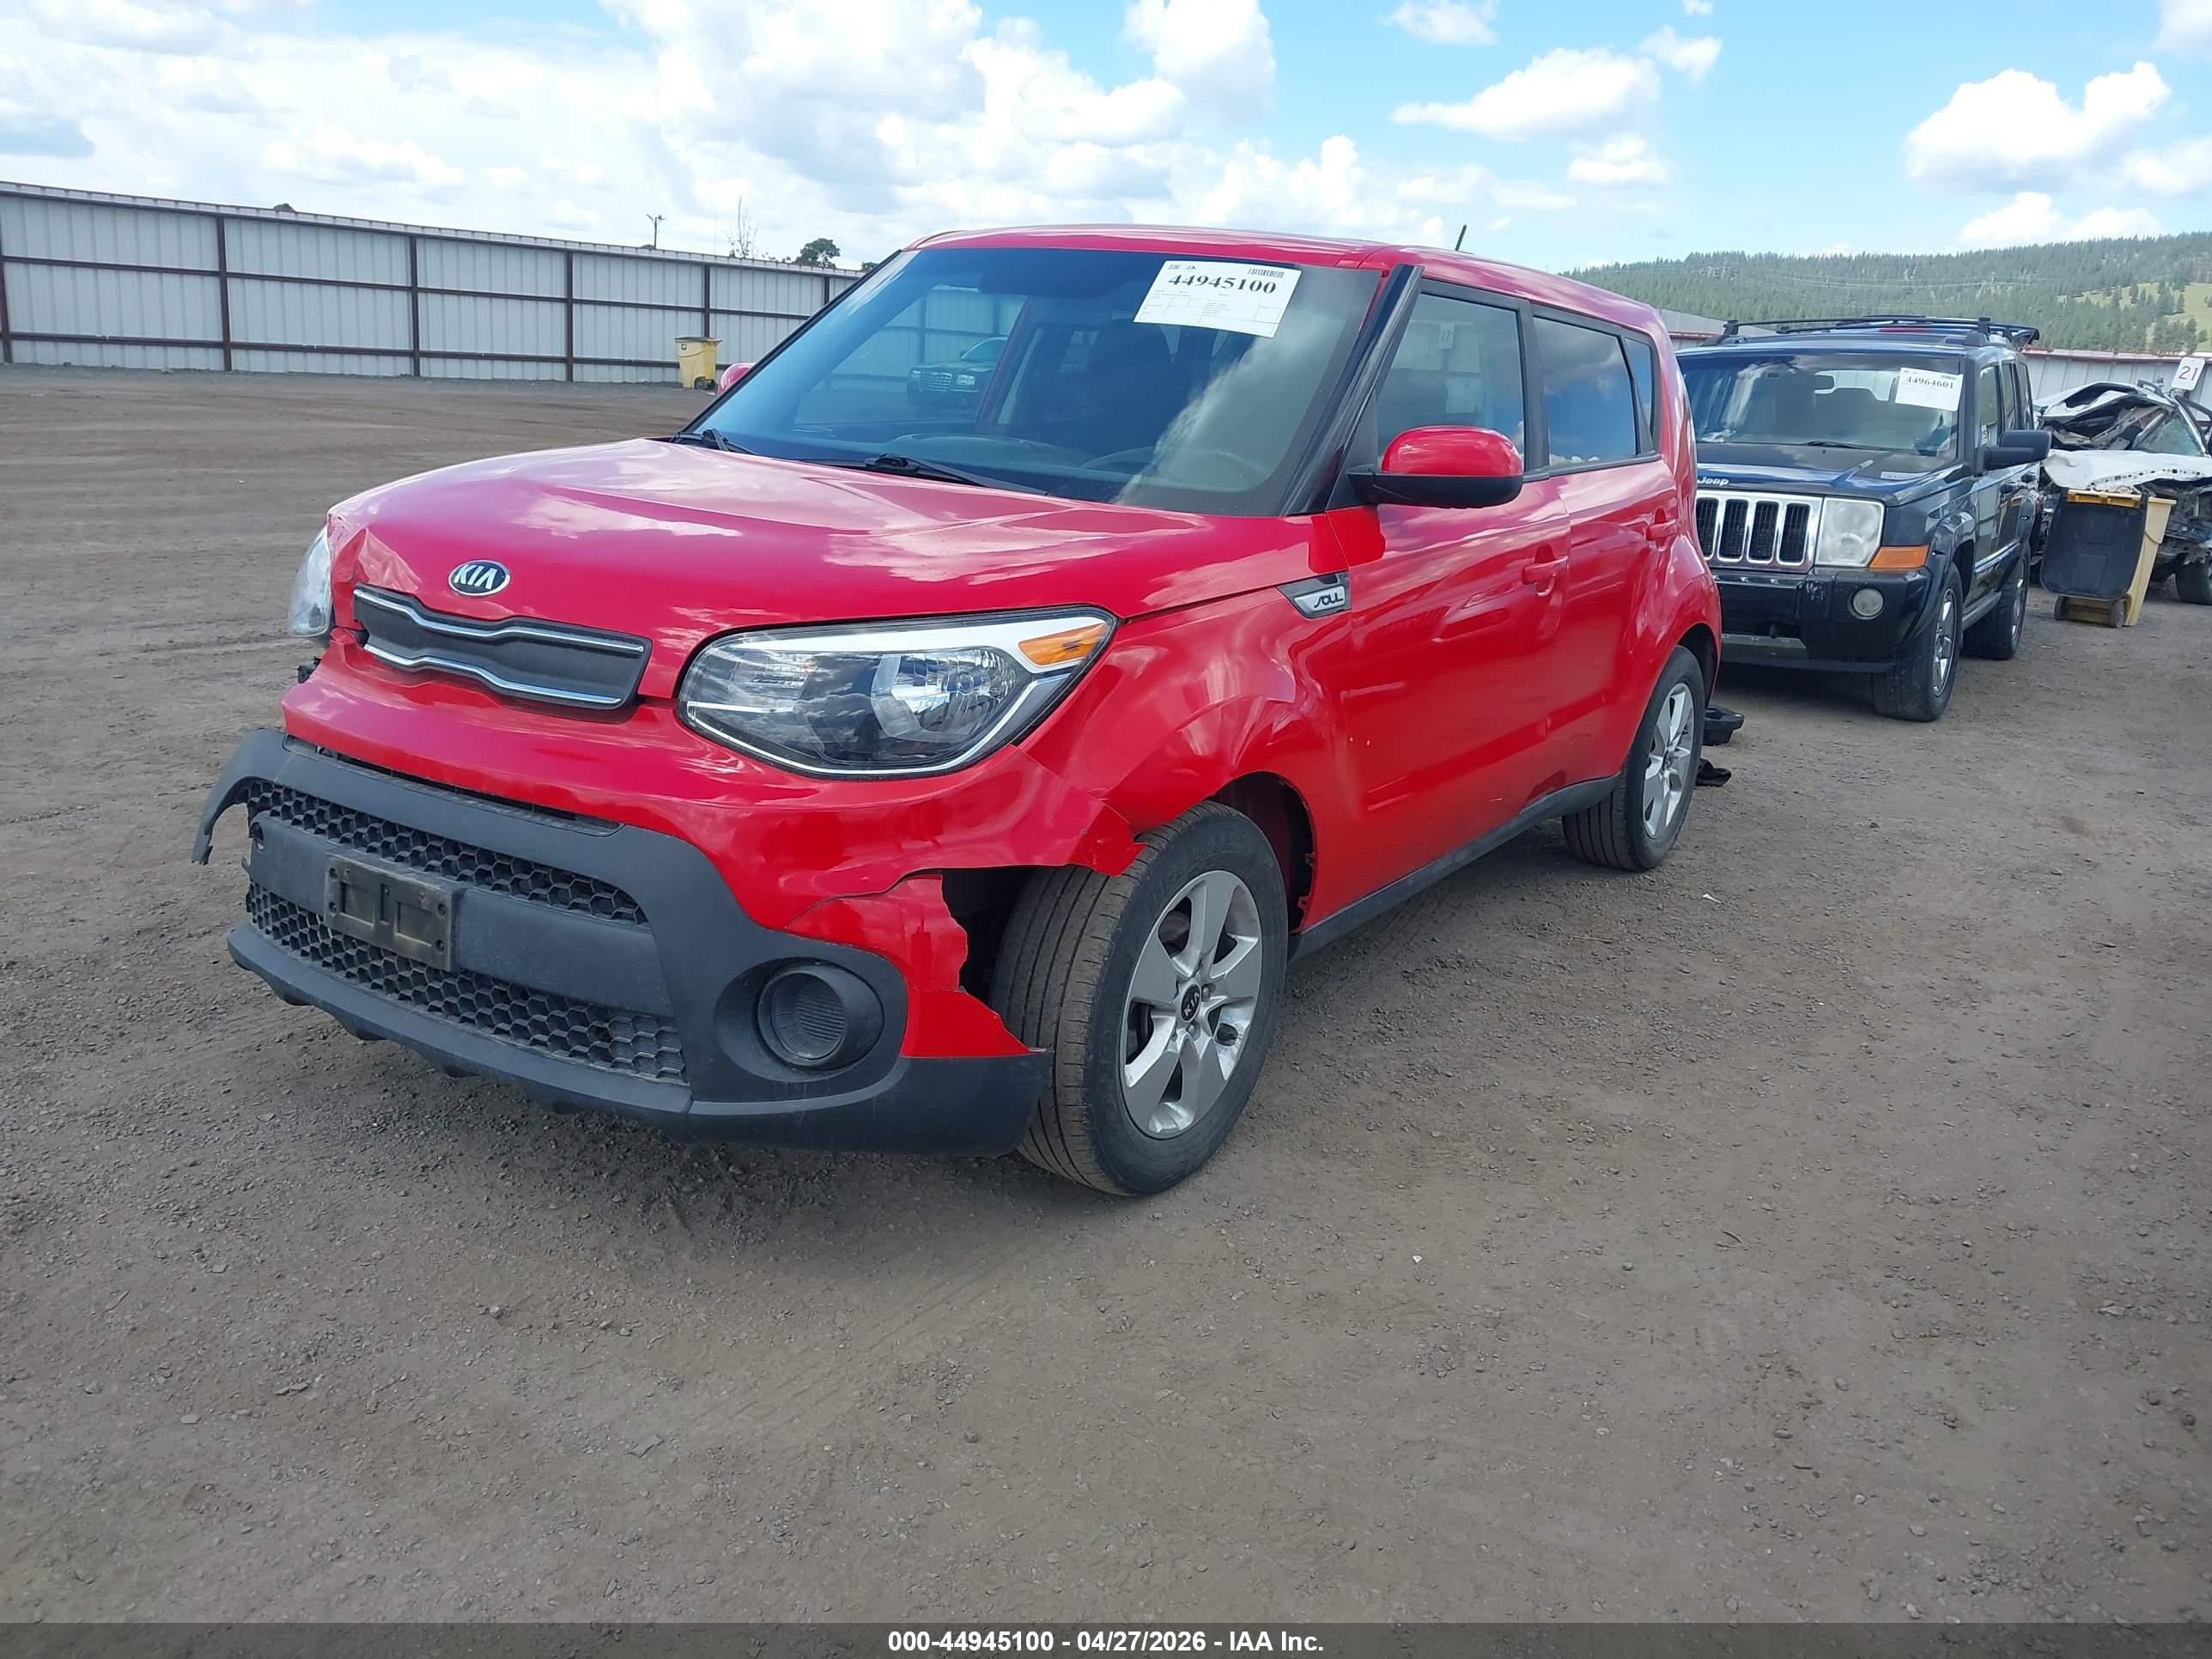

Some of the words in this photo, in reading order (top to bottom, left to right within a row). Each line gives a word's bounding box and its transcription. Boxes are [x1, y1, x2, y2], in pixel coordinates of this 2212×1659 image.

[1169, 274, 1277, 295] 44945100
[2178, 365, 2199, 381] 21
[1905, 375, 1954, 390] 44964601
[1697, 476, 1729, 487] Jeep
[453, 563, 498, 590] KIA
[1313, 592, 1344, 609] SOUL
[1183, 992, 1200, 1018] KIA
